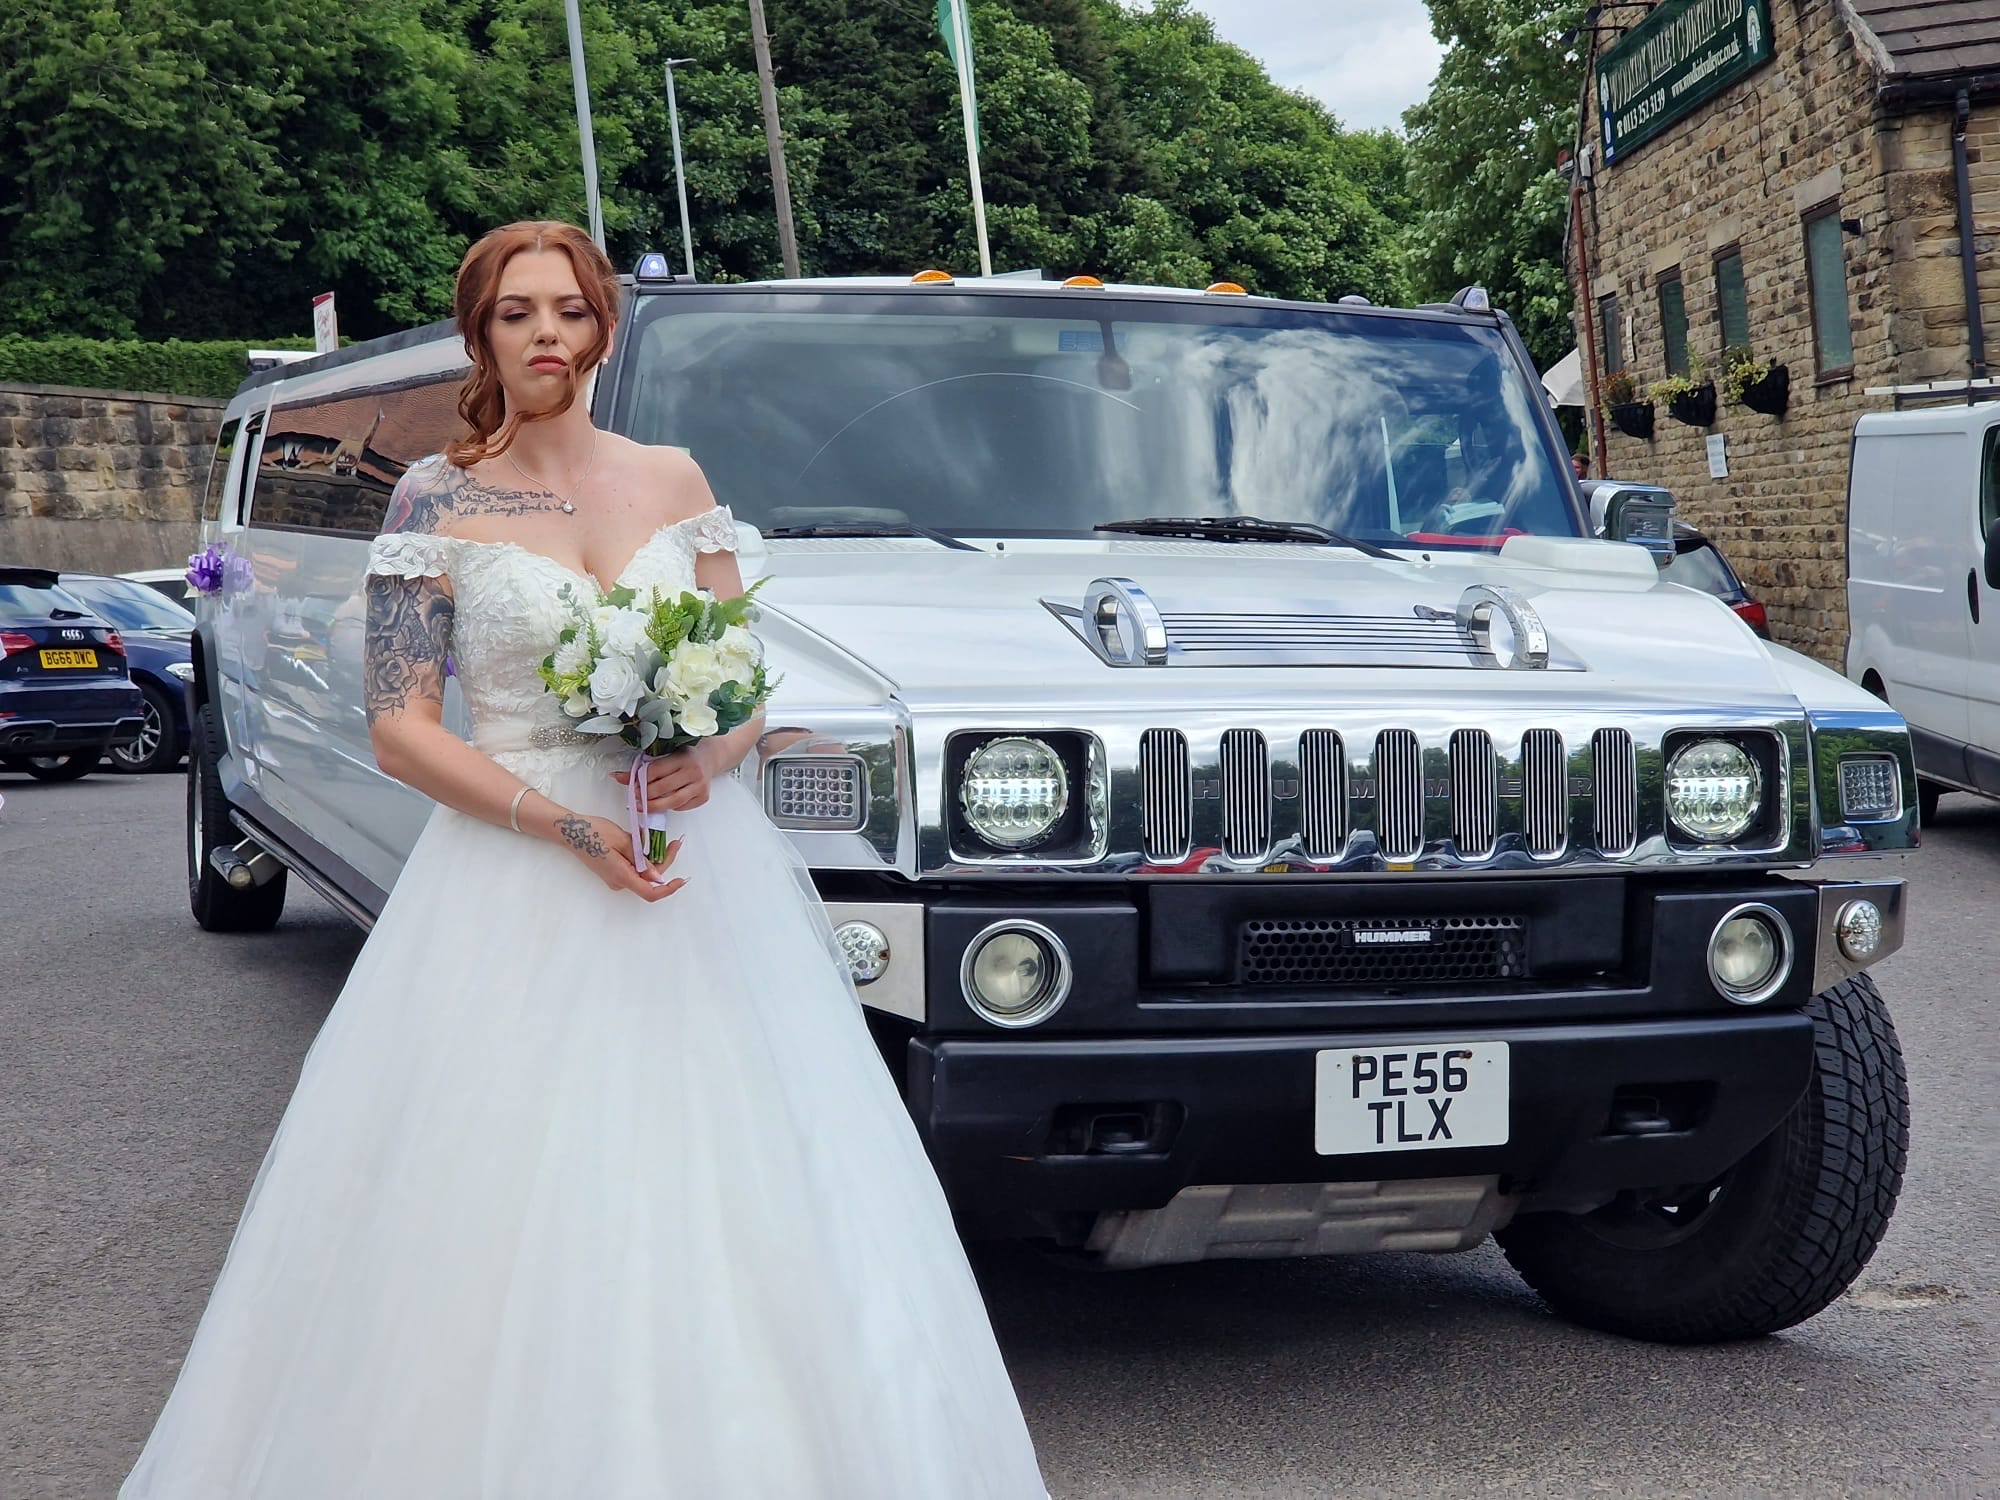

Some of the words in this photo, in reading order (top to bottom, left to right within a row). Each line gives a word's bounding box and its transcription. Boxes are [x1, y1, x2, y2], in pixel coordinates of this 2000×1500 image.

[1609, 46, 1650, 113] WOODKIRK
[1650, 21, 1677, 83] VALLEY
[1676, 0, 1717, 61] COUNTRY
[1623, 107, 1638, 134] 0113
[1638, 98, 1650, 125] 252
[1650, 87, 1666, 118] 3139
[45, 650, 73, 665] BG66
[1354, 930, 1432, 943] HUMMER
[1352, 1050, 1469, 1099] PE56
[1367, 1097, 1453, 1144] TLX
